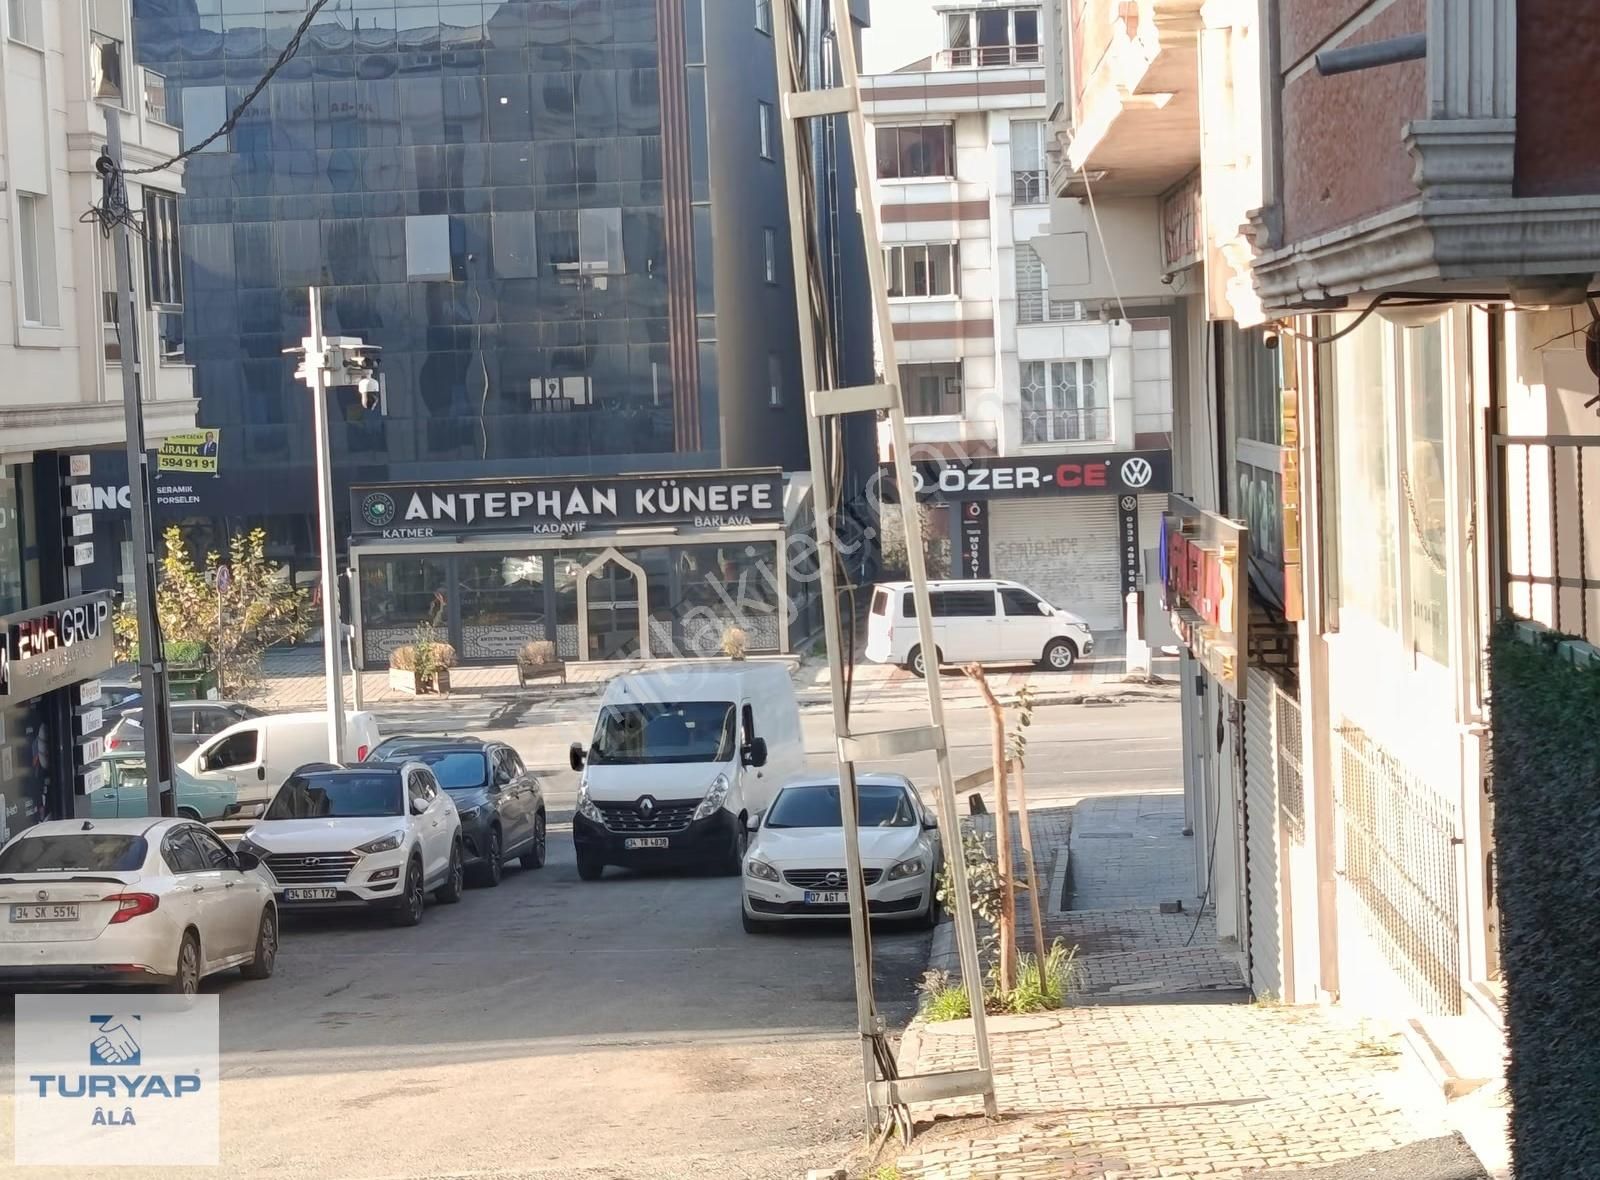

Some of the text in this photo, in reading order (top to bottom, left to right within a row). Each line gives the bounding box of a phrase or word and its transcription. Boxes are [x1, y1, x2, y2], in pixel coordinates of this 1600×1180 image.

[162, 457, 215, 468] 594 91 91
[157, 495, 200, 504] PORSELEN
[404, 485, 618, 525] ANTEPHAN
[635, 480, 772, 515] KÜNEFE
[533, 521, 587, 534] KADAYIF
[694, 515, 752, 528] BAKLAVA
[383, 527, 434, 539] KATMER
[61, 600, 108, 648] GRUP
[321, 888, 336, 898] 172
[16, 905, 76, 919] 34 SK 5514
